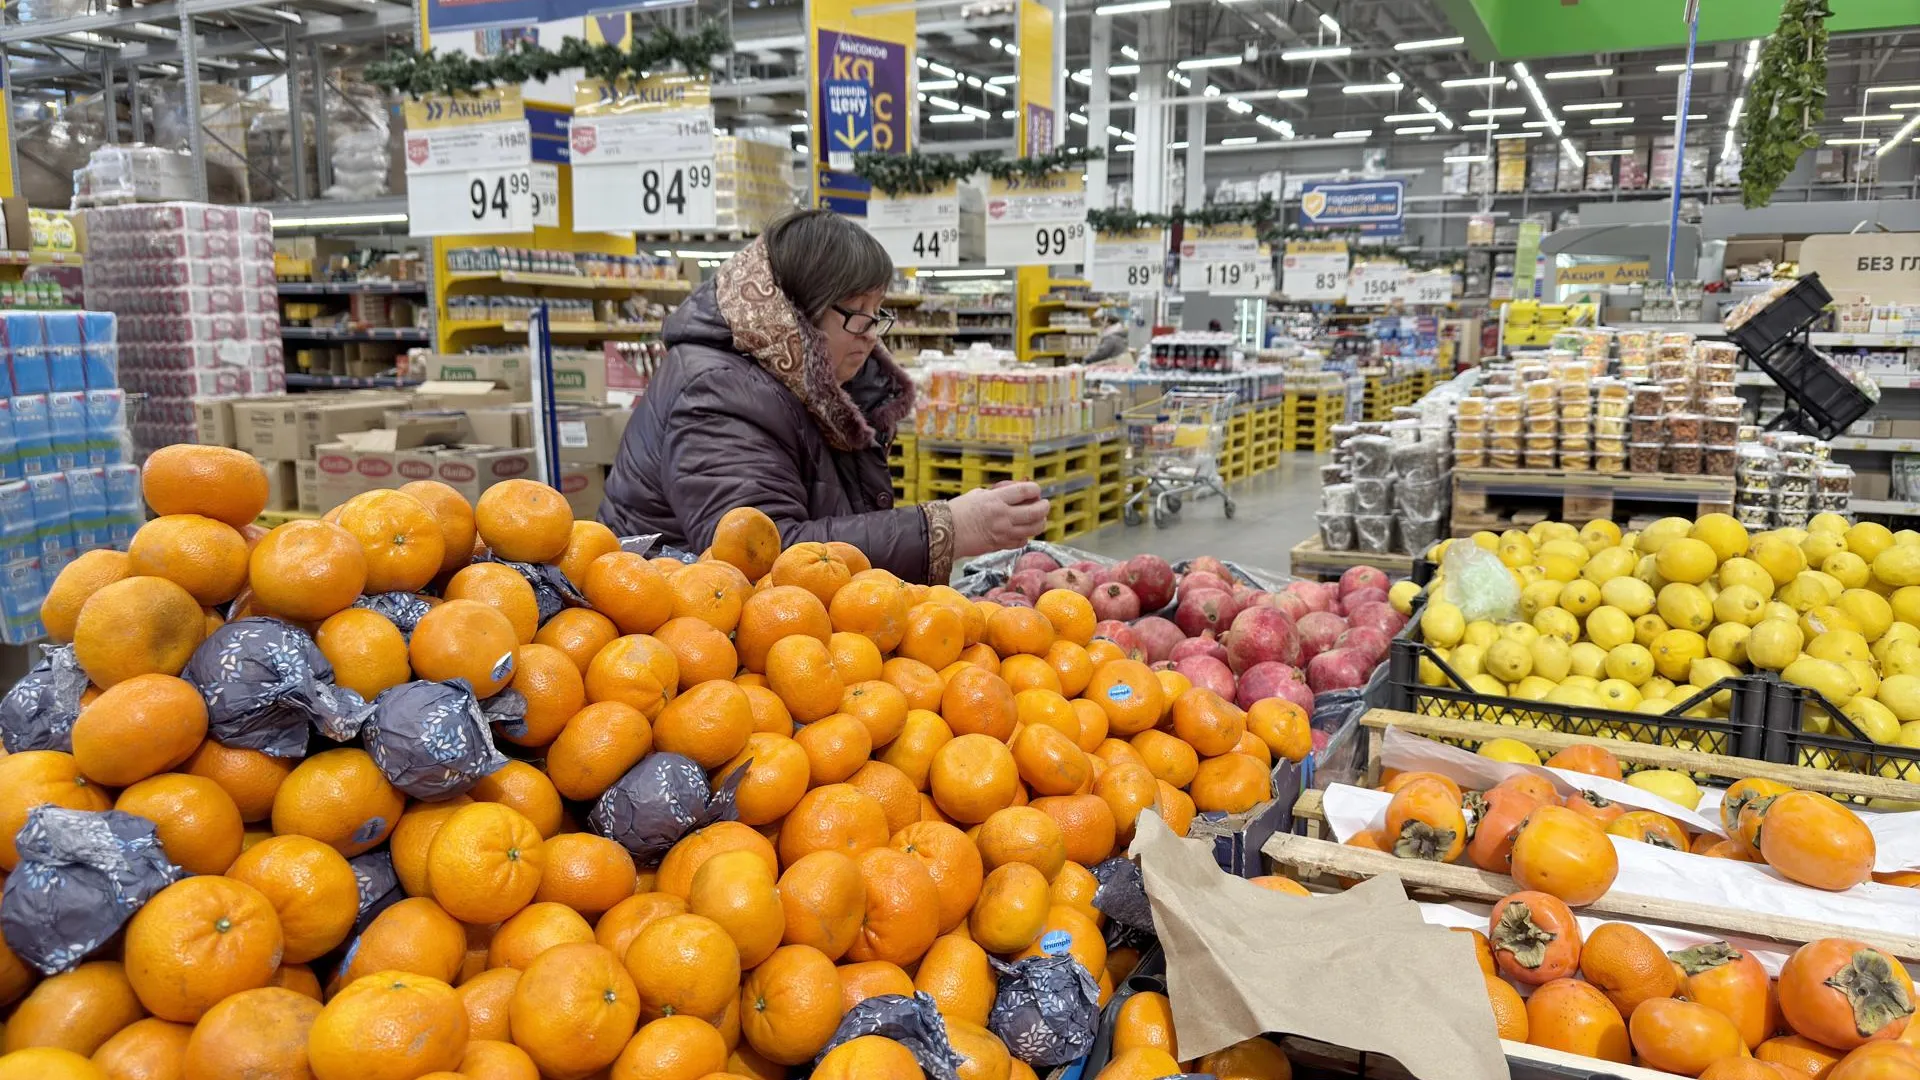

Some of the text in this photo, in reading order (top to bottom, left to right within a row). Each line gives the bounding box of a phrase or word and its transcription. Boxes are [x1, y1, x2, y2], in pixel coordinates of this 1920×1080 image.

[448, 98, 502, 119] Акция
[830, 98, 868, 118] цену
[470, 172, 530, 220] 94 99
[642, 165, 712, 216] 84 99
[912, 230, 941, 259] 44
[1035, 222, 1085, 256] 99 99
[1205, 263, 1240, 285] 119
[1857, 256, 1894, 271] БЕЗ
[1127, 264, 1150, 285] 89
[1316, 272, 1336, 290] 83
[1043, 938, 1071, 951] triumph
